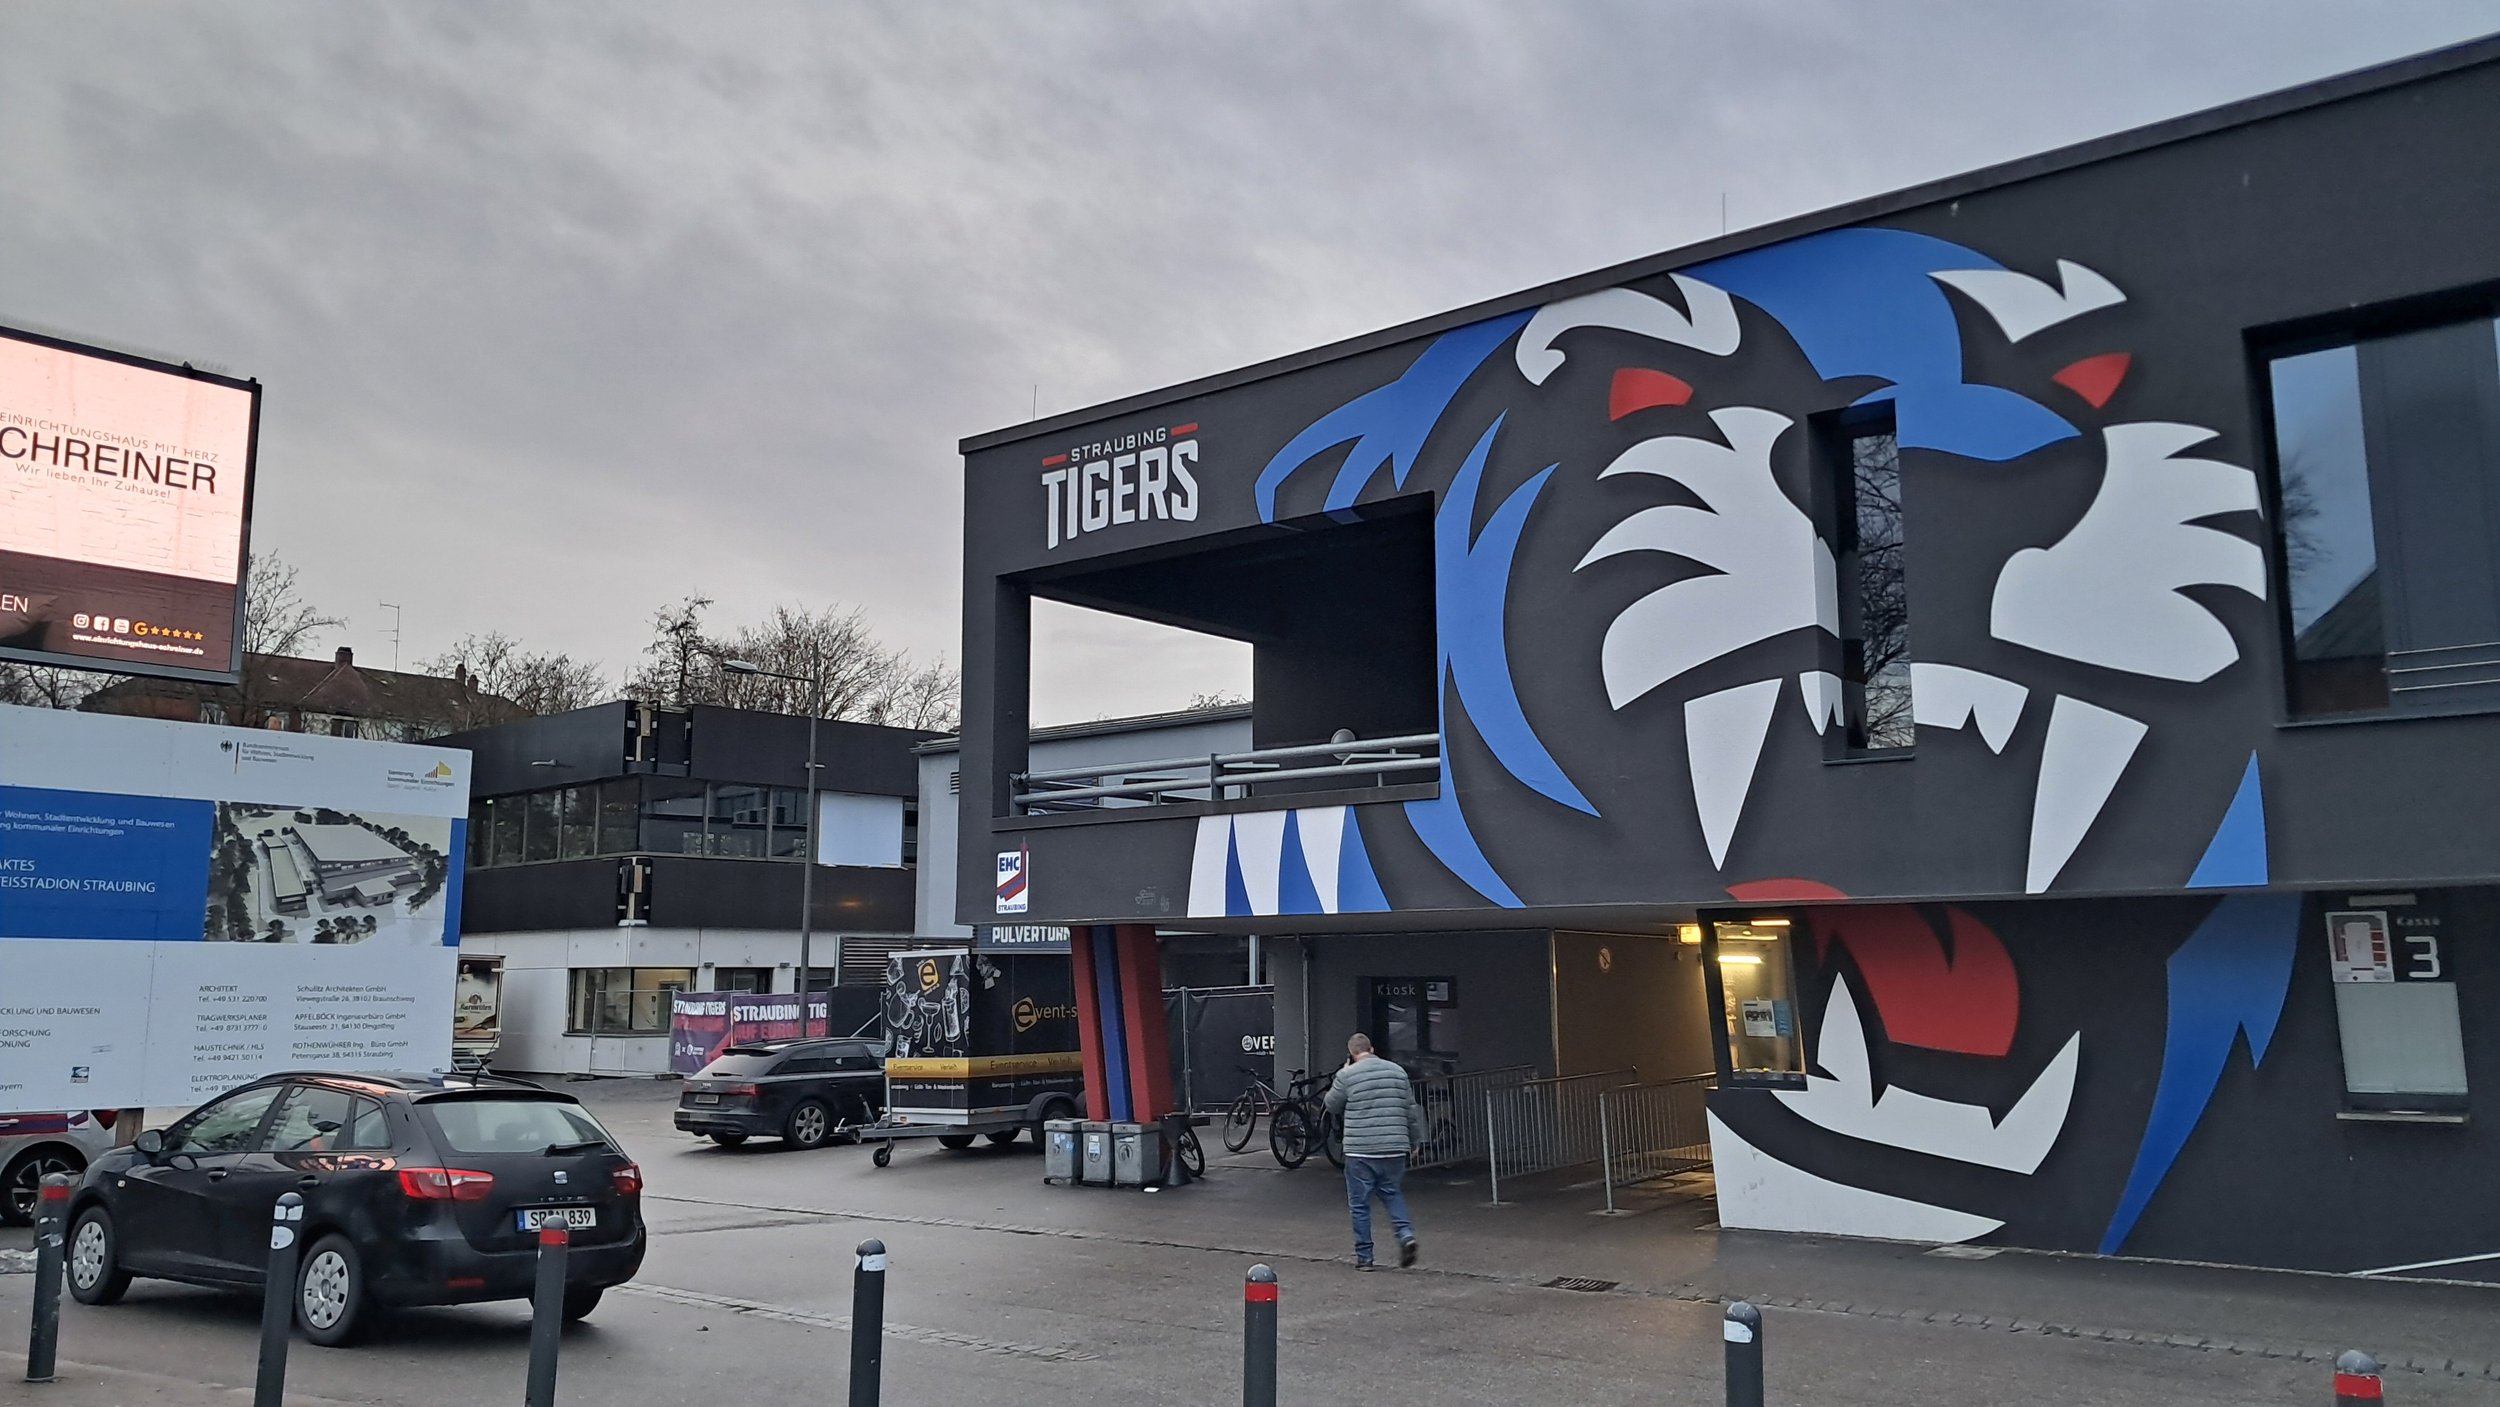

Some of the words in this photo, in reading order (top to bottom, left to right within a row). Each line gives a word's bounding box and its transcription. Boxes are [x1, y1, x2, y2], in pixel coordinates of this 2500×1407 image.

[155, 442, 178, 455] MIT
[184, 448, 219, 463] HERZ
[1071, 427, 1167, 462] STRAUBING
[0, 426, 216, 494] CHREINER
[15, 462, 40, 476] Wir
[46, 469, 86, 484] lieben
[91, 476, 109, 487] Ihr
[114, 480, 171, 498] Zuhause!
[1042, 439, 1199, 550] TIGERS
[0, 594, 28, 613] EN
[5, 810, 41, 821] Wohnen,
[44, 812, 116, 826] Stadtentwicklung
[118, 818, 133, 826] und
[135, 818, 175, 828] Bauwesen
[13, 822, 66, 832] kommunaler
[68, 825, 124, 836] Einrichtungen
[998, 856, 1020, 872] EHC
[0, 875, 79, 890] EISSTADION
[83, 879, 156, 893] STRAUBING
[998, 903, 1026, 912] STRAUBING
[2396, 916, 2441, 927] Kasse
[2404, 936, 2441, 978] 3
[1377, 983, 1416, 996] Kiosk
[36, 1007, 55, 1015] UND
[57, 1007, 101, 1015] BAUWESEN
[191, 1073, 258, 1082] ELEKTROPLANUNG
[568, 1209, 591, 1225] 839
